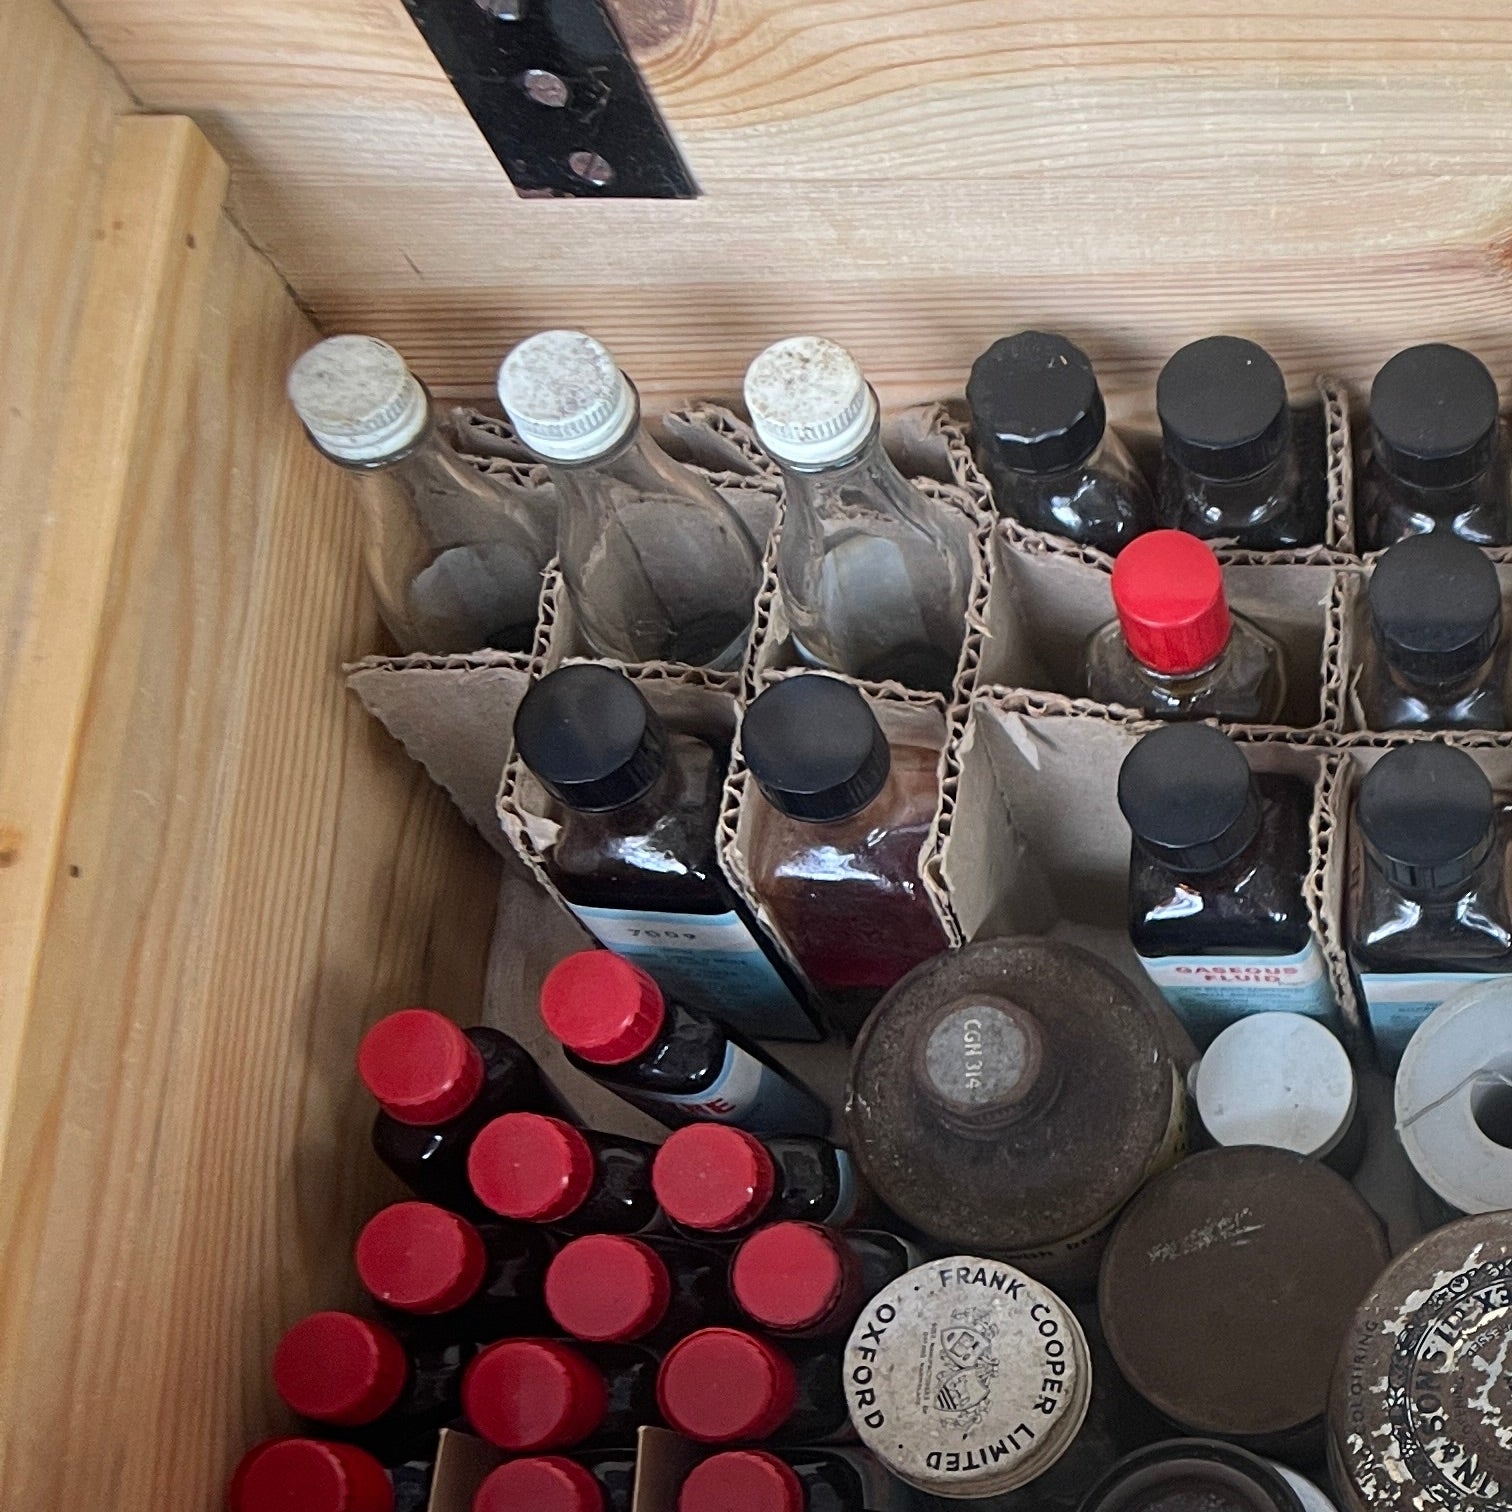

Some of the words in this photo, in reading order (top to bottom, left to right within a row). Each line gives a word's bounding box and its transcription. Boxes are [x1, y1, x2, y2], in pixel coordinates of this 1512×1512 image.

[939, 1266, 1025, 1300] FRANK
[851, 1303, 897, 1430] OXFORD
[1030, 1303, 1065, 1415] COOPER
[926, 1423, 1035, 1472] LIMITED
